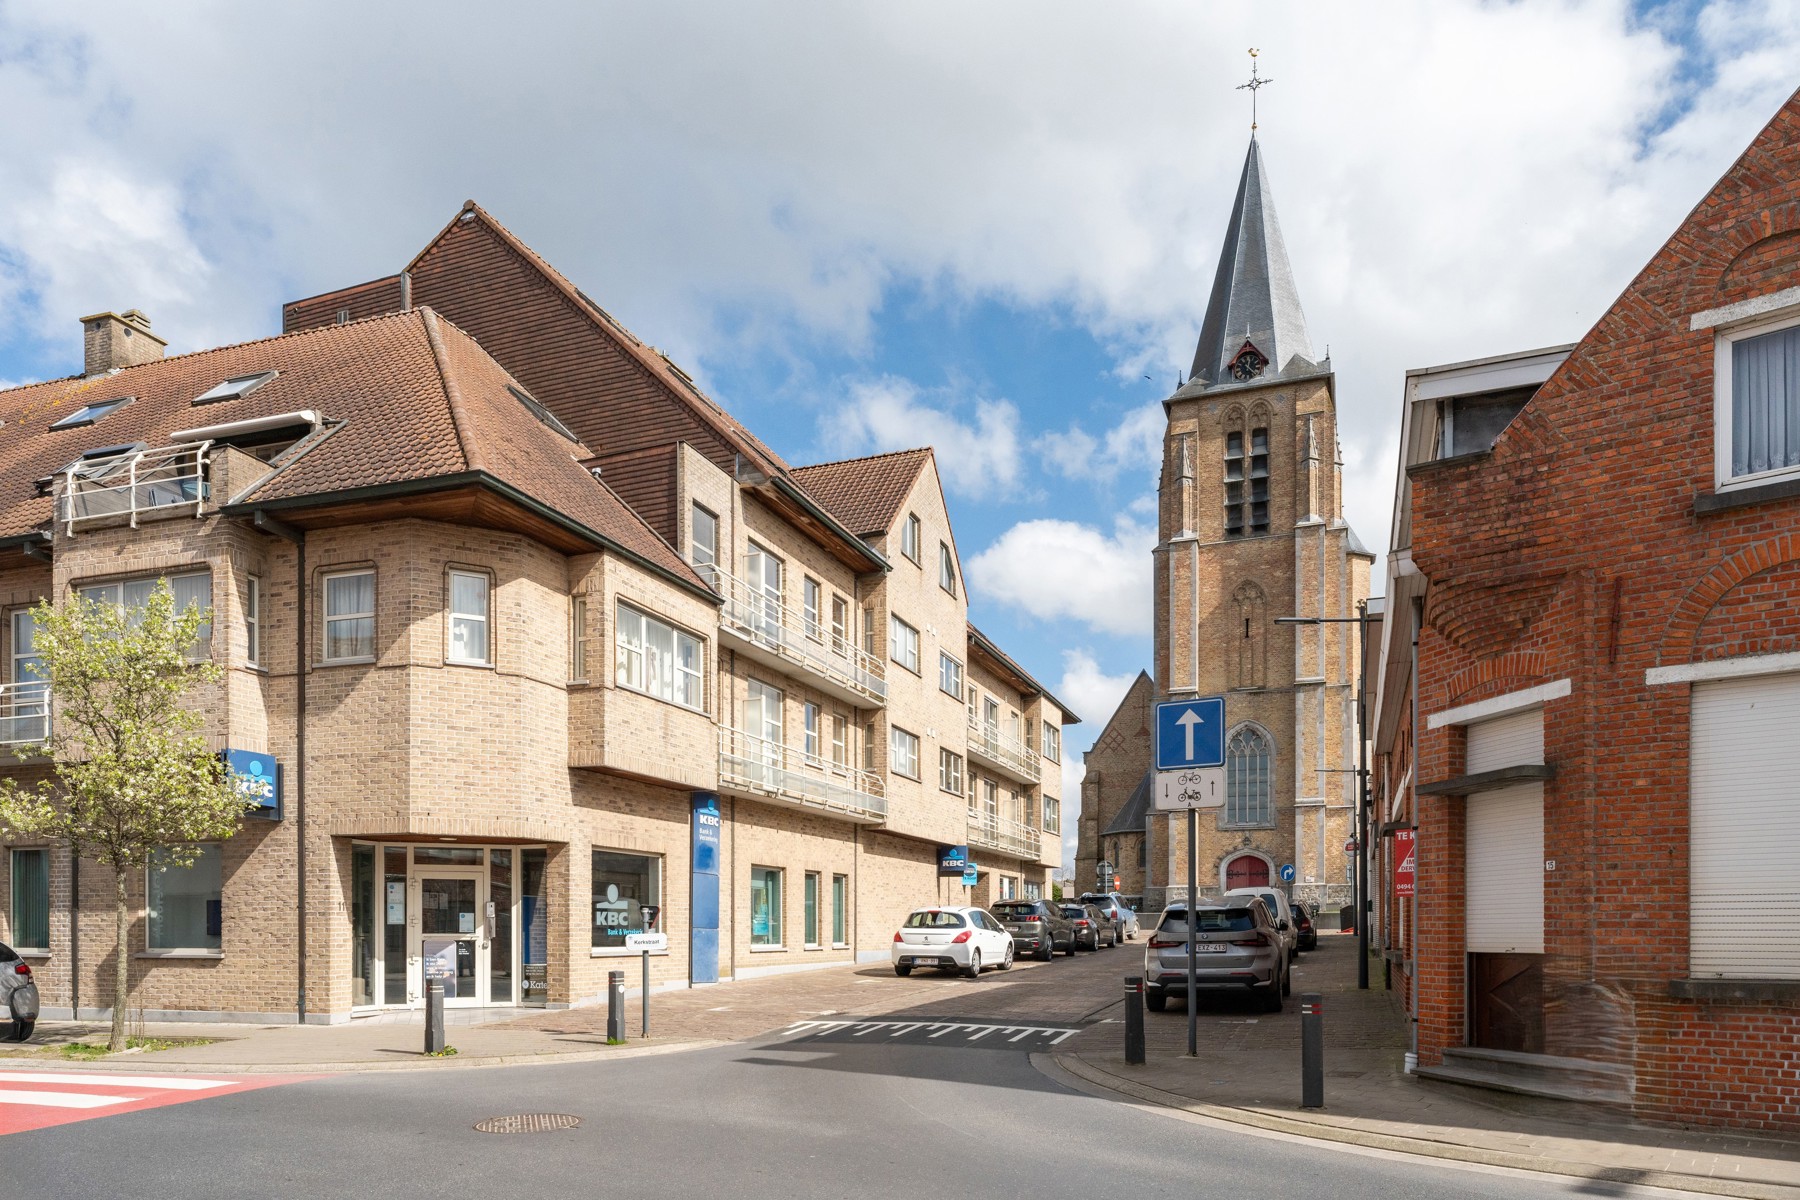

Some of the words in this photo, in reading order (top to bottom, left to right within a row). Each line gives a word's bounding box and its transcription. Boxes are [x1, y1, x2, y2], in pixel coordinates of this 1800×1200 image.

[699, 814, 719, 827] KBC
[1396, 831, 1408, 841] TE
[596, 912, 629, 926] KBC
